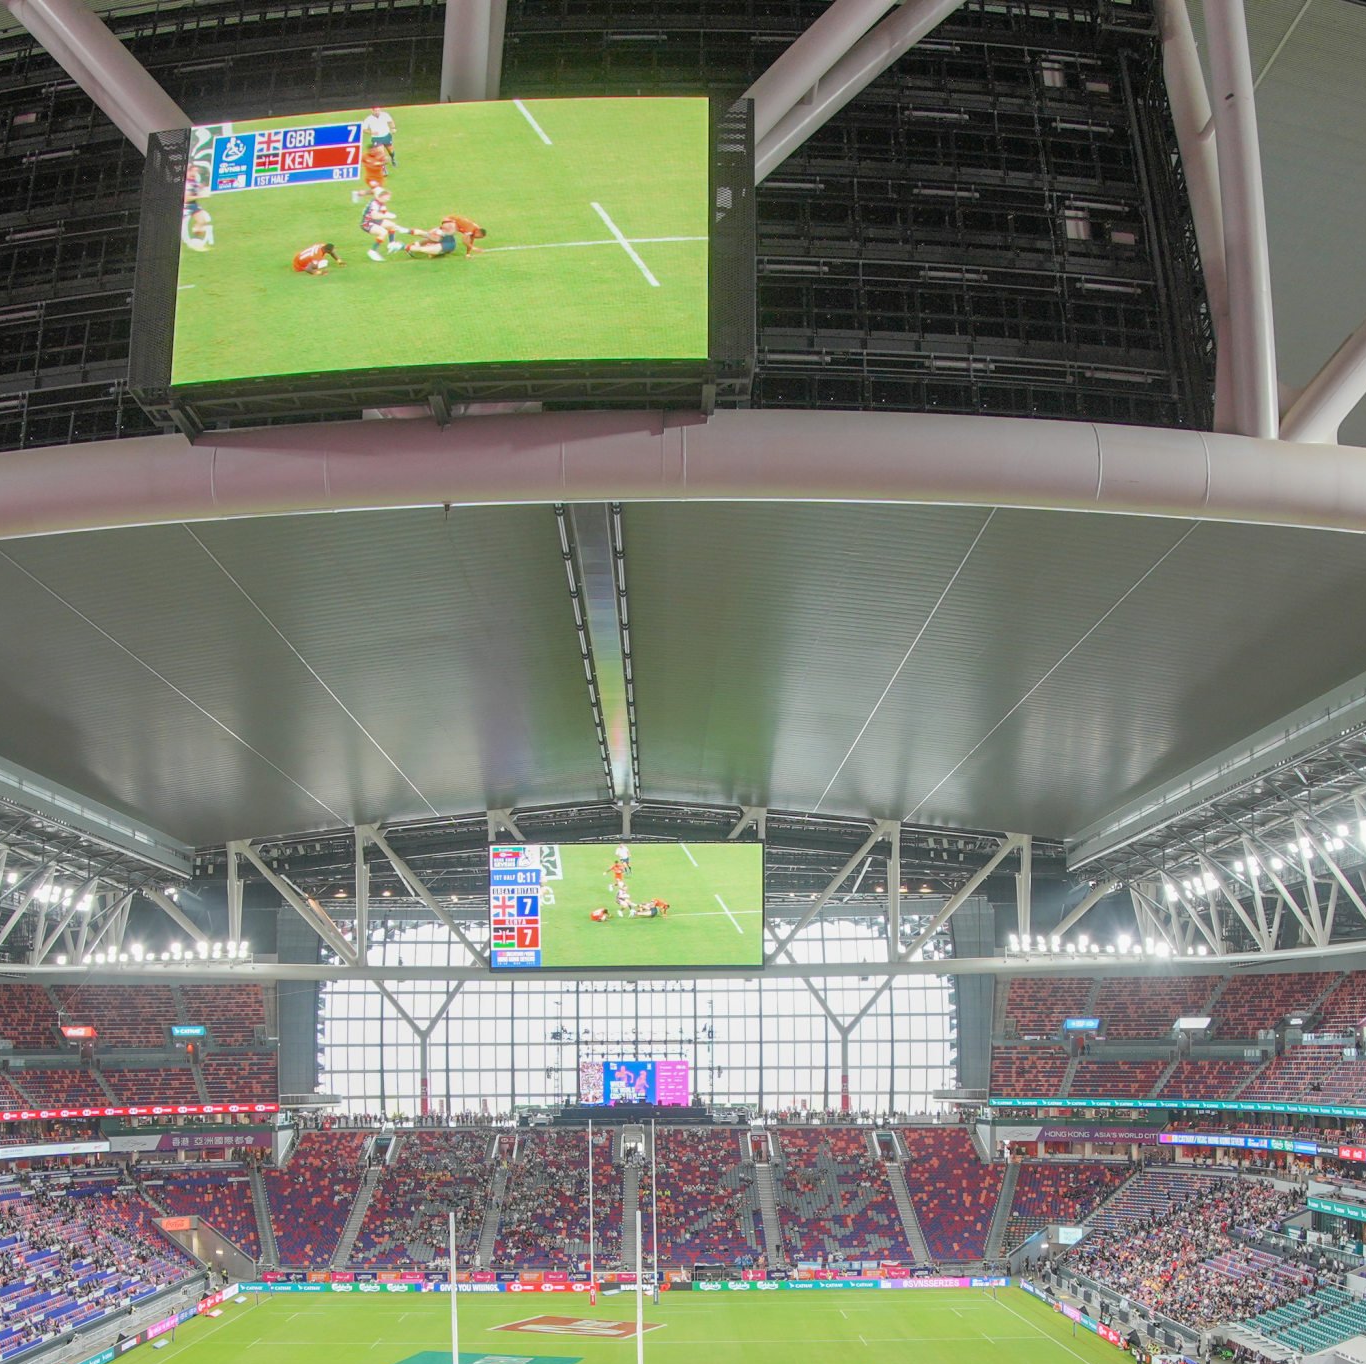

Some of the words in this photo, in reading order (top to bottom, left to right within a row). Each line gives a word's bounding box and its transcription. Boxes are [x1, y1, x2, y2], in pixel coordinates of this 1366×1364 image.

[286, 130, 314, 148] GBR
[347, 126, 357, 142] 7
[286, 152, 314, 169] KEN
[346, 148, 356, 164] 7
[257, 176, 269, 185] 1ST
[270, 174, 290, 184] HALF
[332, 168, 354, 179] 0:11
[516, 872, 536, 883] 0:11
[522, 898, 532, 914] 7
[523, 929, 532, 946] 7
[903, 1278, 960, 1287] @SVNSSERIES
